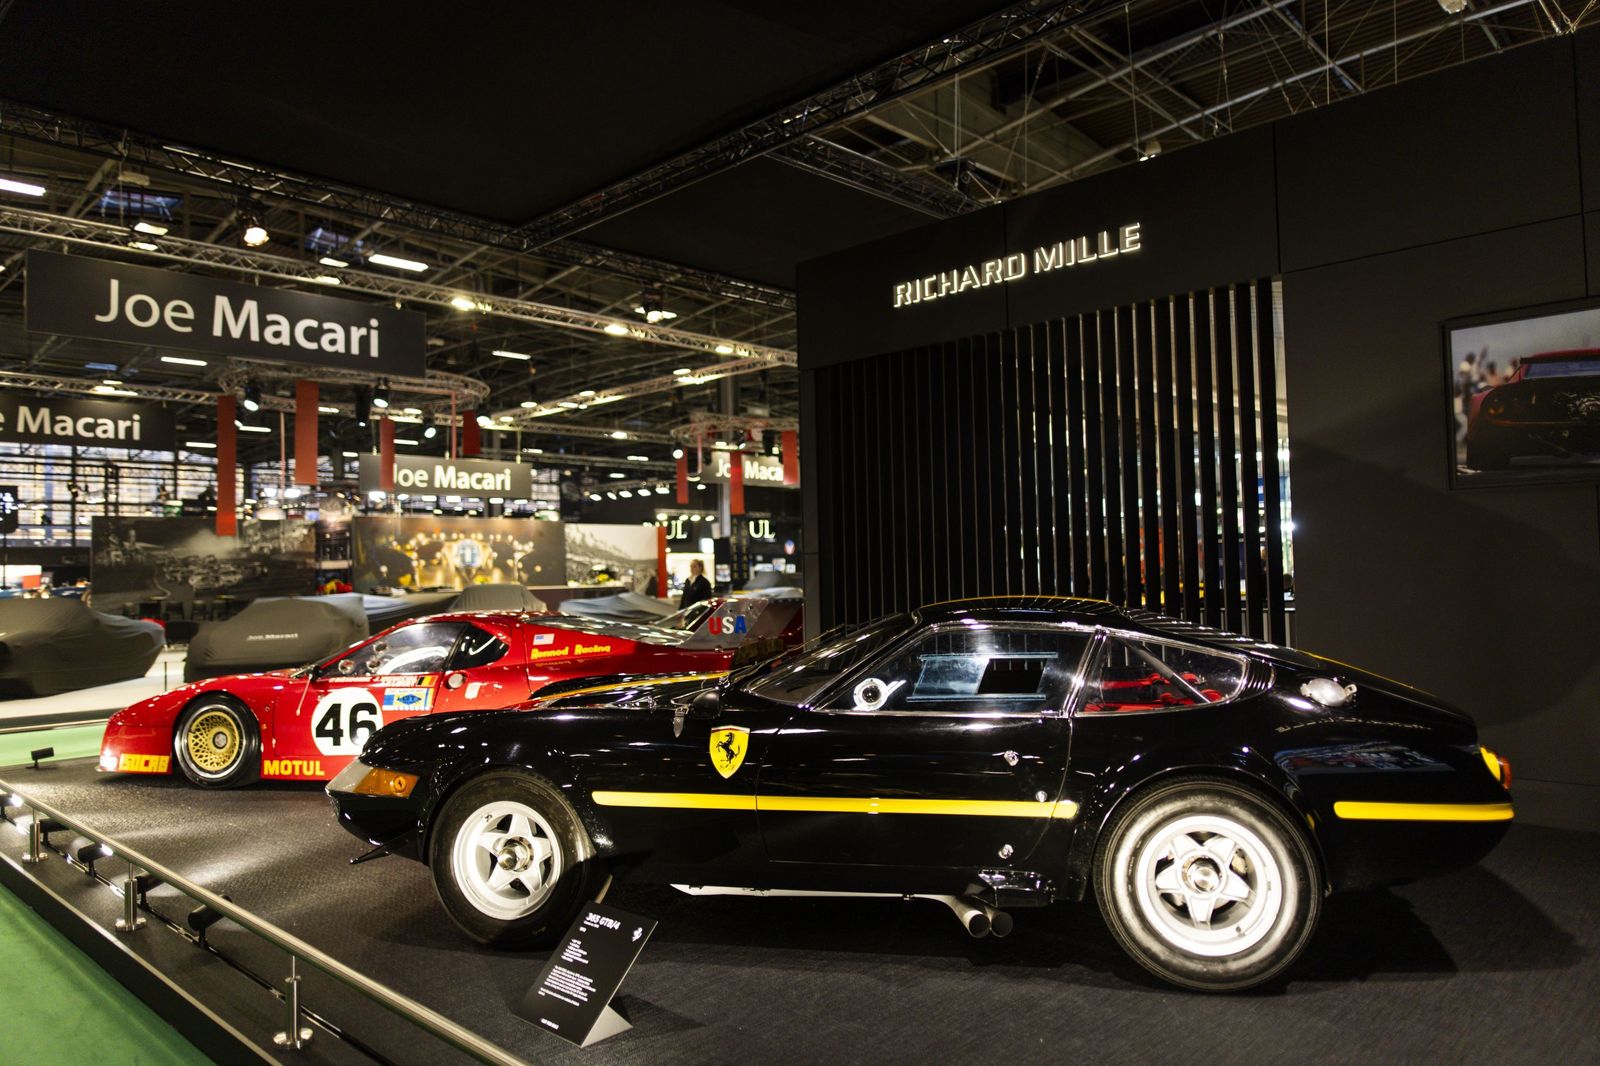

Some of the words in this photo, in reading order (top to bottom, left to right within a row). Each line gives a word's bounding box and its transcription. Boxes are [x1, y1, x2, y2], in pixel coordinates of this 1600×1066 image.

[893, 252, 1025, 308] RICHARD
[1033, 222, 1141, 274] MILLE
[95, 278, 195, 333] Joe
[212, 295, 380, 358] Macari
[16, 405, 141, 441] Macari
[434, 465, 512, 491] Macari
[708, 615, 747, 635] USA
[574, 644, 611, 656] Racing
[315, 702, 378, 747] 46
[263, 759, 325, 776] MOTUL
[585, 912, 601, 924] 365
[599, 917, 621, 930] GTB/4
